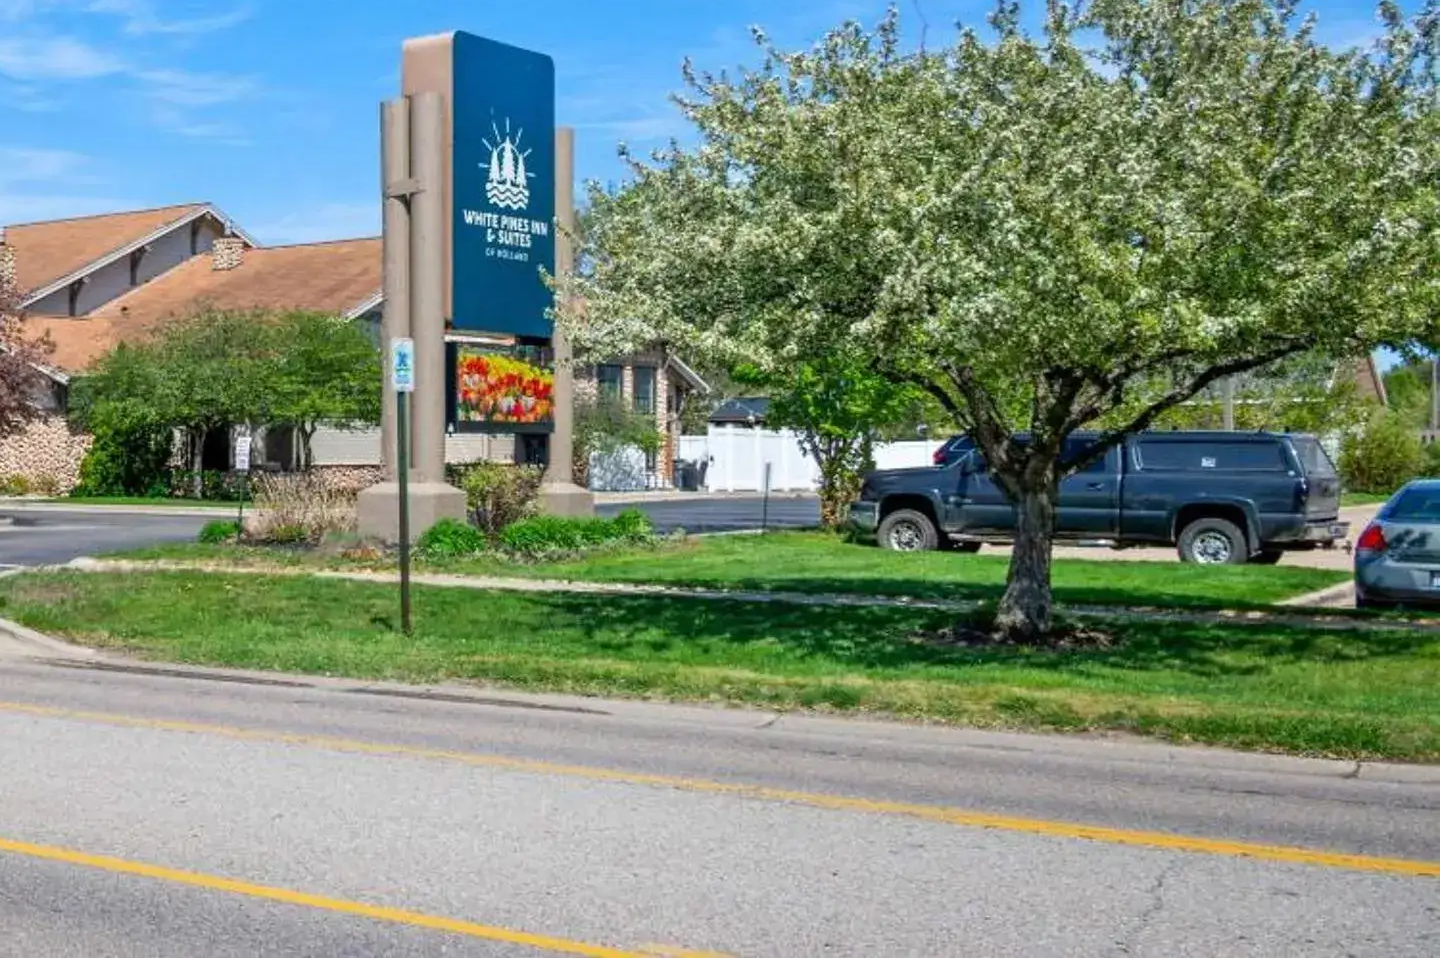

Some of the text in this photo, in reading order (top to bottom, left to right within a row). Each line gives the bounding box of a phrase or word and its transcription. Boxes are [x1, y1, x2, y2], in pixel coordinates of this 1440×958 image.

[463, 209, 548, 236] WHITE PINES INN
[487, 228, 531, 248] & SUITES
